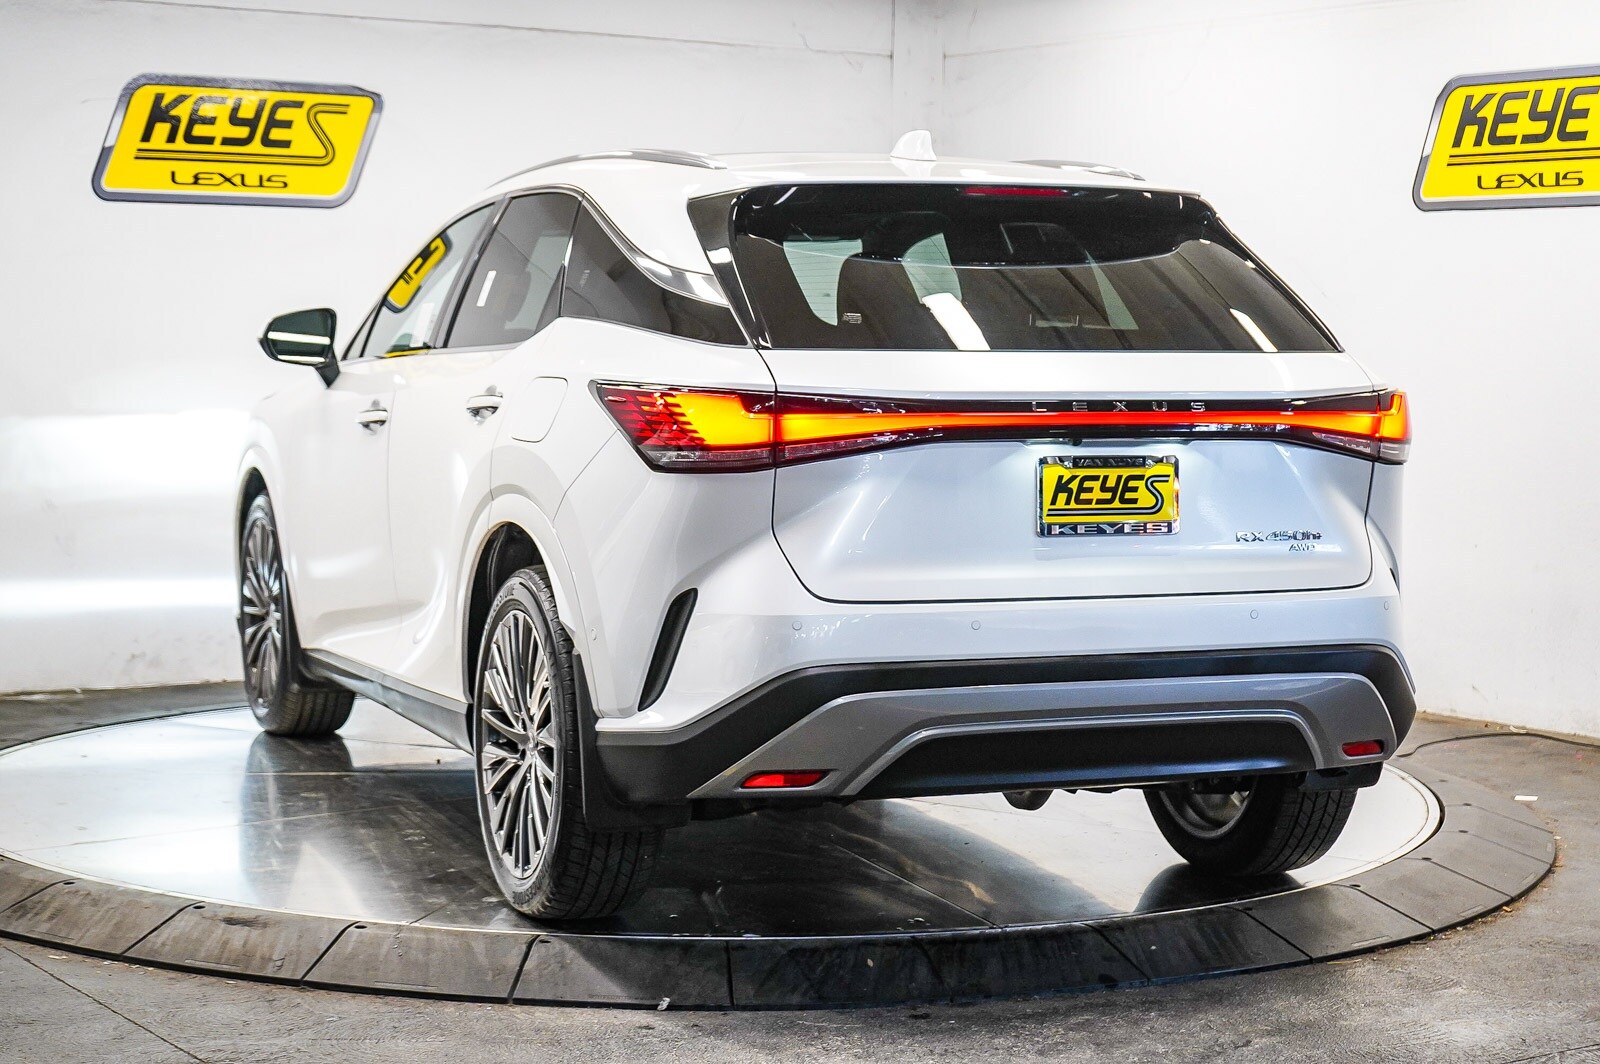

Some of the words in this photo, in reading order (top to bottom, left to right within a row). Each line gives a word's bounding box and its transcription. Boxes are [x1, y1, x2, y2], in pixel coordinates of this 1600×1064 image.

[134, 92, 351, 167] KEYES
[1446, 85, 1600, 166] KEYE
[170, 170, 288, 189] LEXUS
[1477, 170, 1584, 190] LEXUS
[1031, 400, 1207, 413] LEXUS
[1046, 474, 1171, 517] KEYES
[1051, 522, 1169, 535] KEYES
